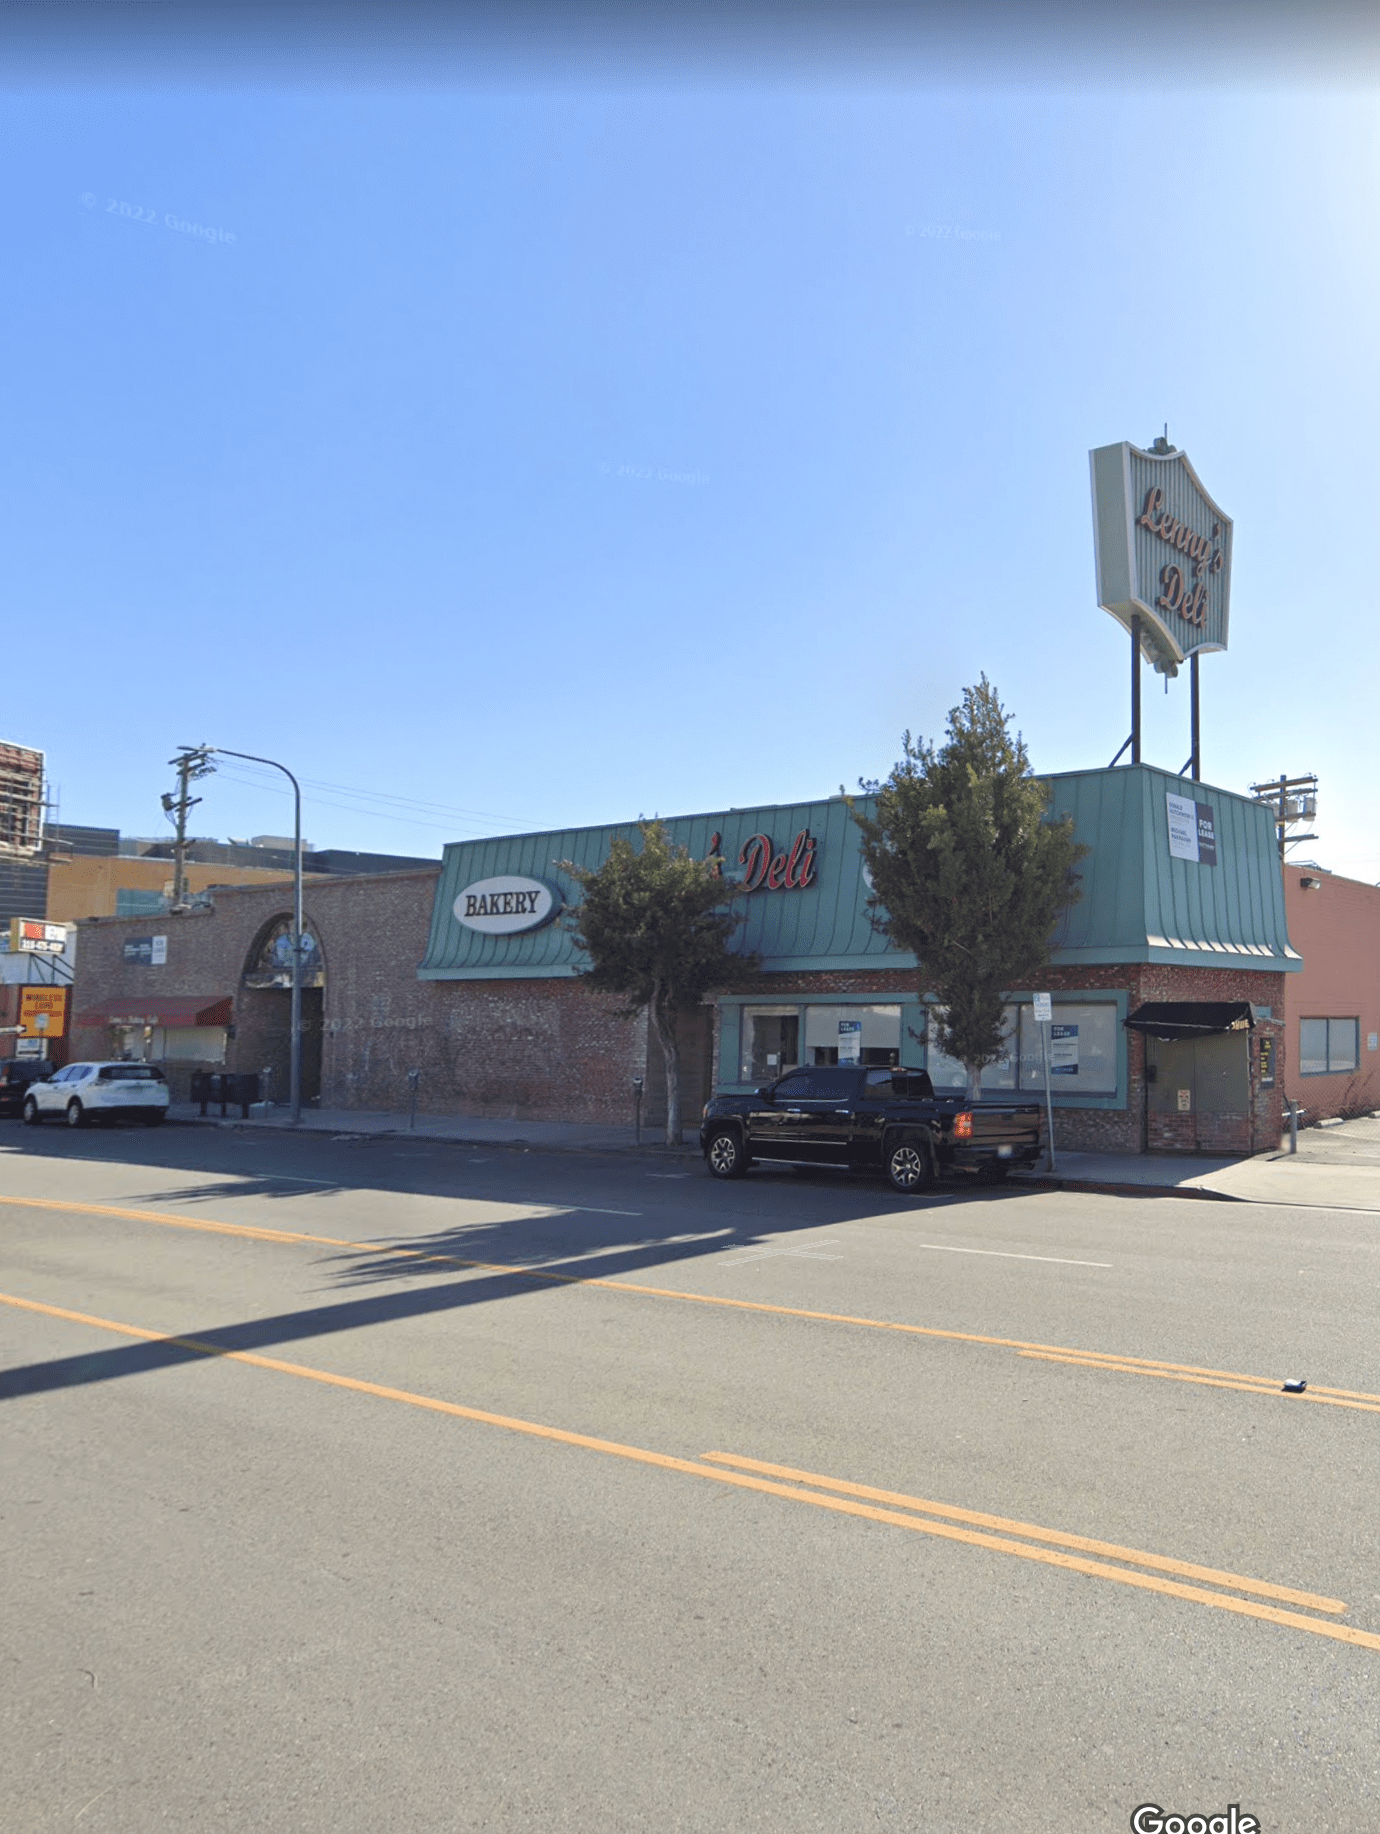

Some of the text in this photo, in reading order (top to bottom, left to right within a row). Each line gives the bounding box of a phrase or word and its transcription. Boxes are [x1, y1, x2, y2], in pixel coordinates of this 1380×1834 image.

[1140, 486, 1224, 577] Lenny's
[1159, 563, 1209, 629] Deli
[1198, 819, 1213, 831] FOR
[1198, 829, 1215, 840] LEASE
[735, 828, 816, 892] Deli
[464, 890, 541, 917] BAKERY
